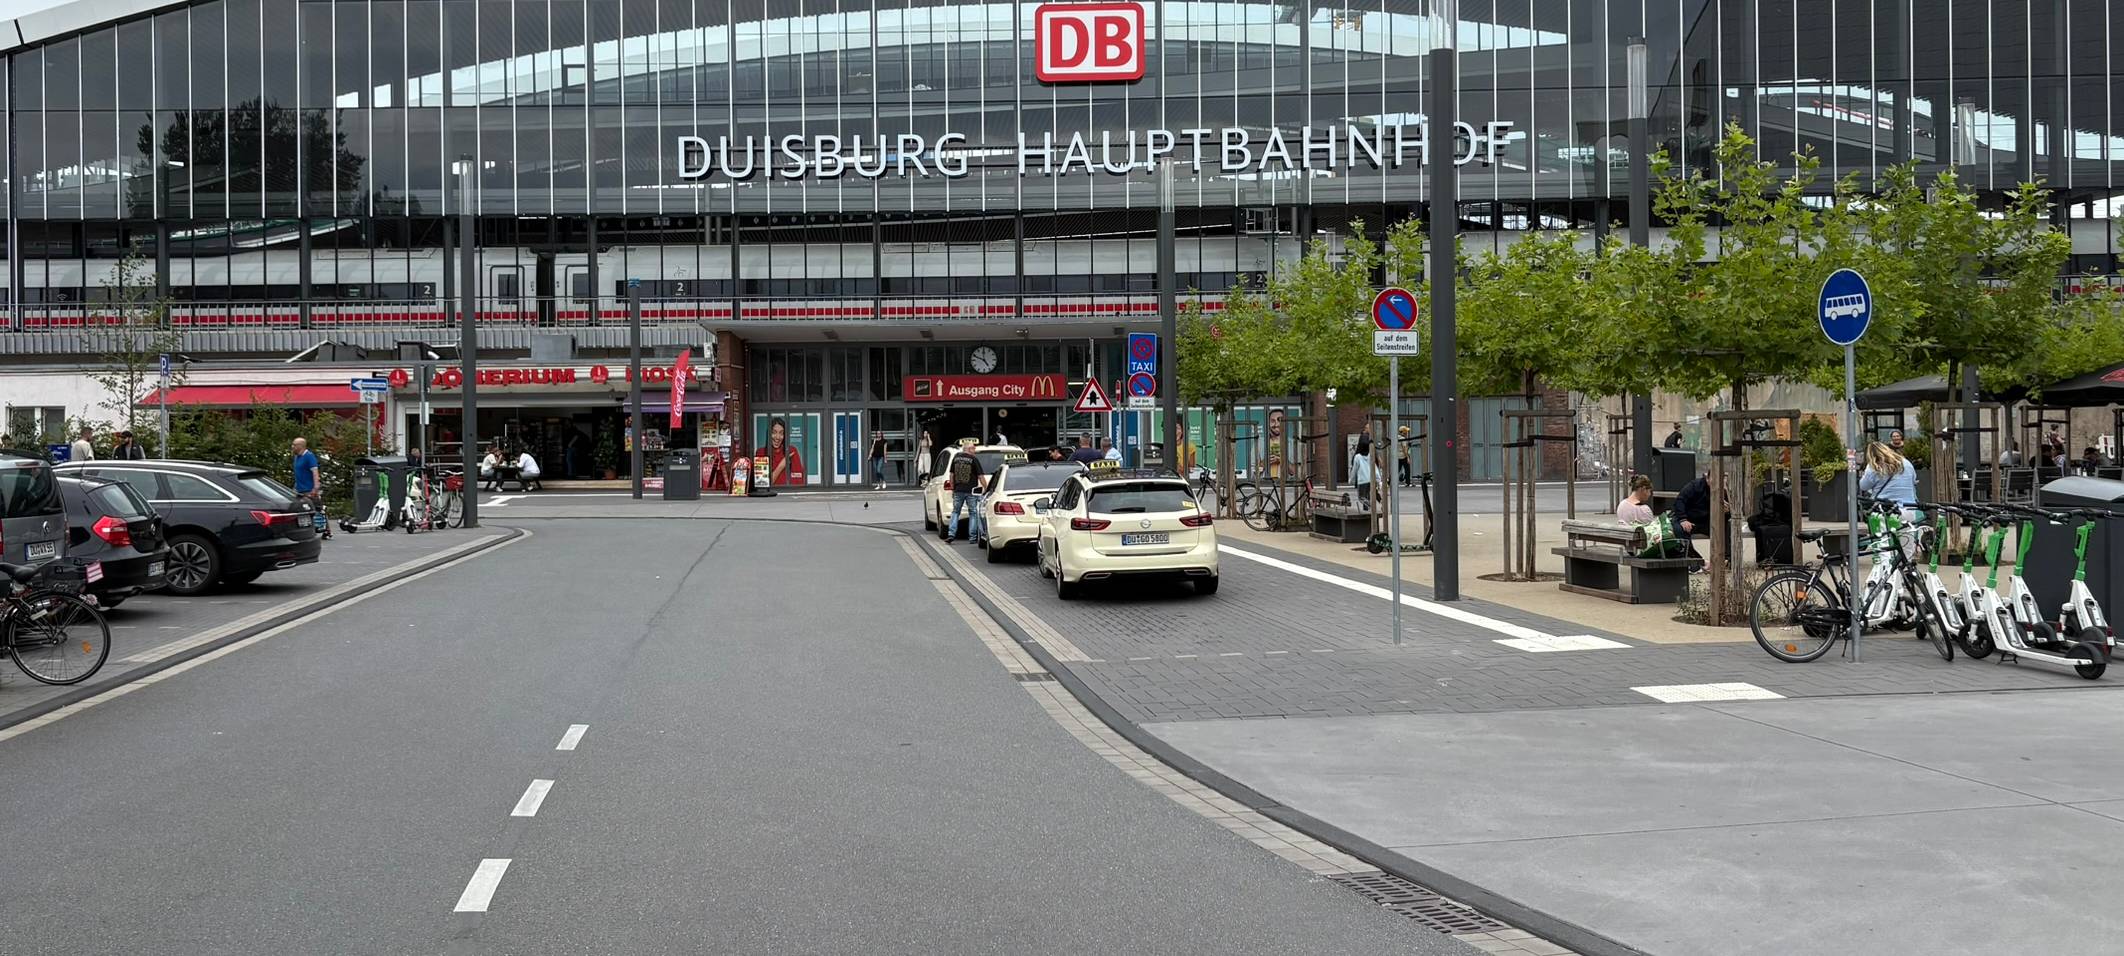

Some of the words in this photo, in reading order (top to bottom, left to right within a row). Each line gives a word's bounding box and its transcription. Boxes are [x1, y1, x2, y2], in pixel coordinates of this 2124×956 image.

[1049, 15, 1133, 68] DB
[677, 132, 968, 179] DUISBURG
[1017, 120, 1514, 176] HAUPTBAHNHOF
[1256, 273, 1263, 283] 2
[424, 285, 431, 295] 2
[677, 282, 684, 291] 2
[1376, 343, 1416, 351] Seitenstreifen
[1131, 361, 1153, 371] TAXI
[949, 384, 999, 398] Ausgang
[1002, 384, 1025, 397] City
